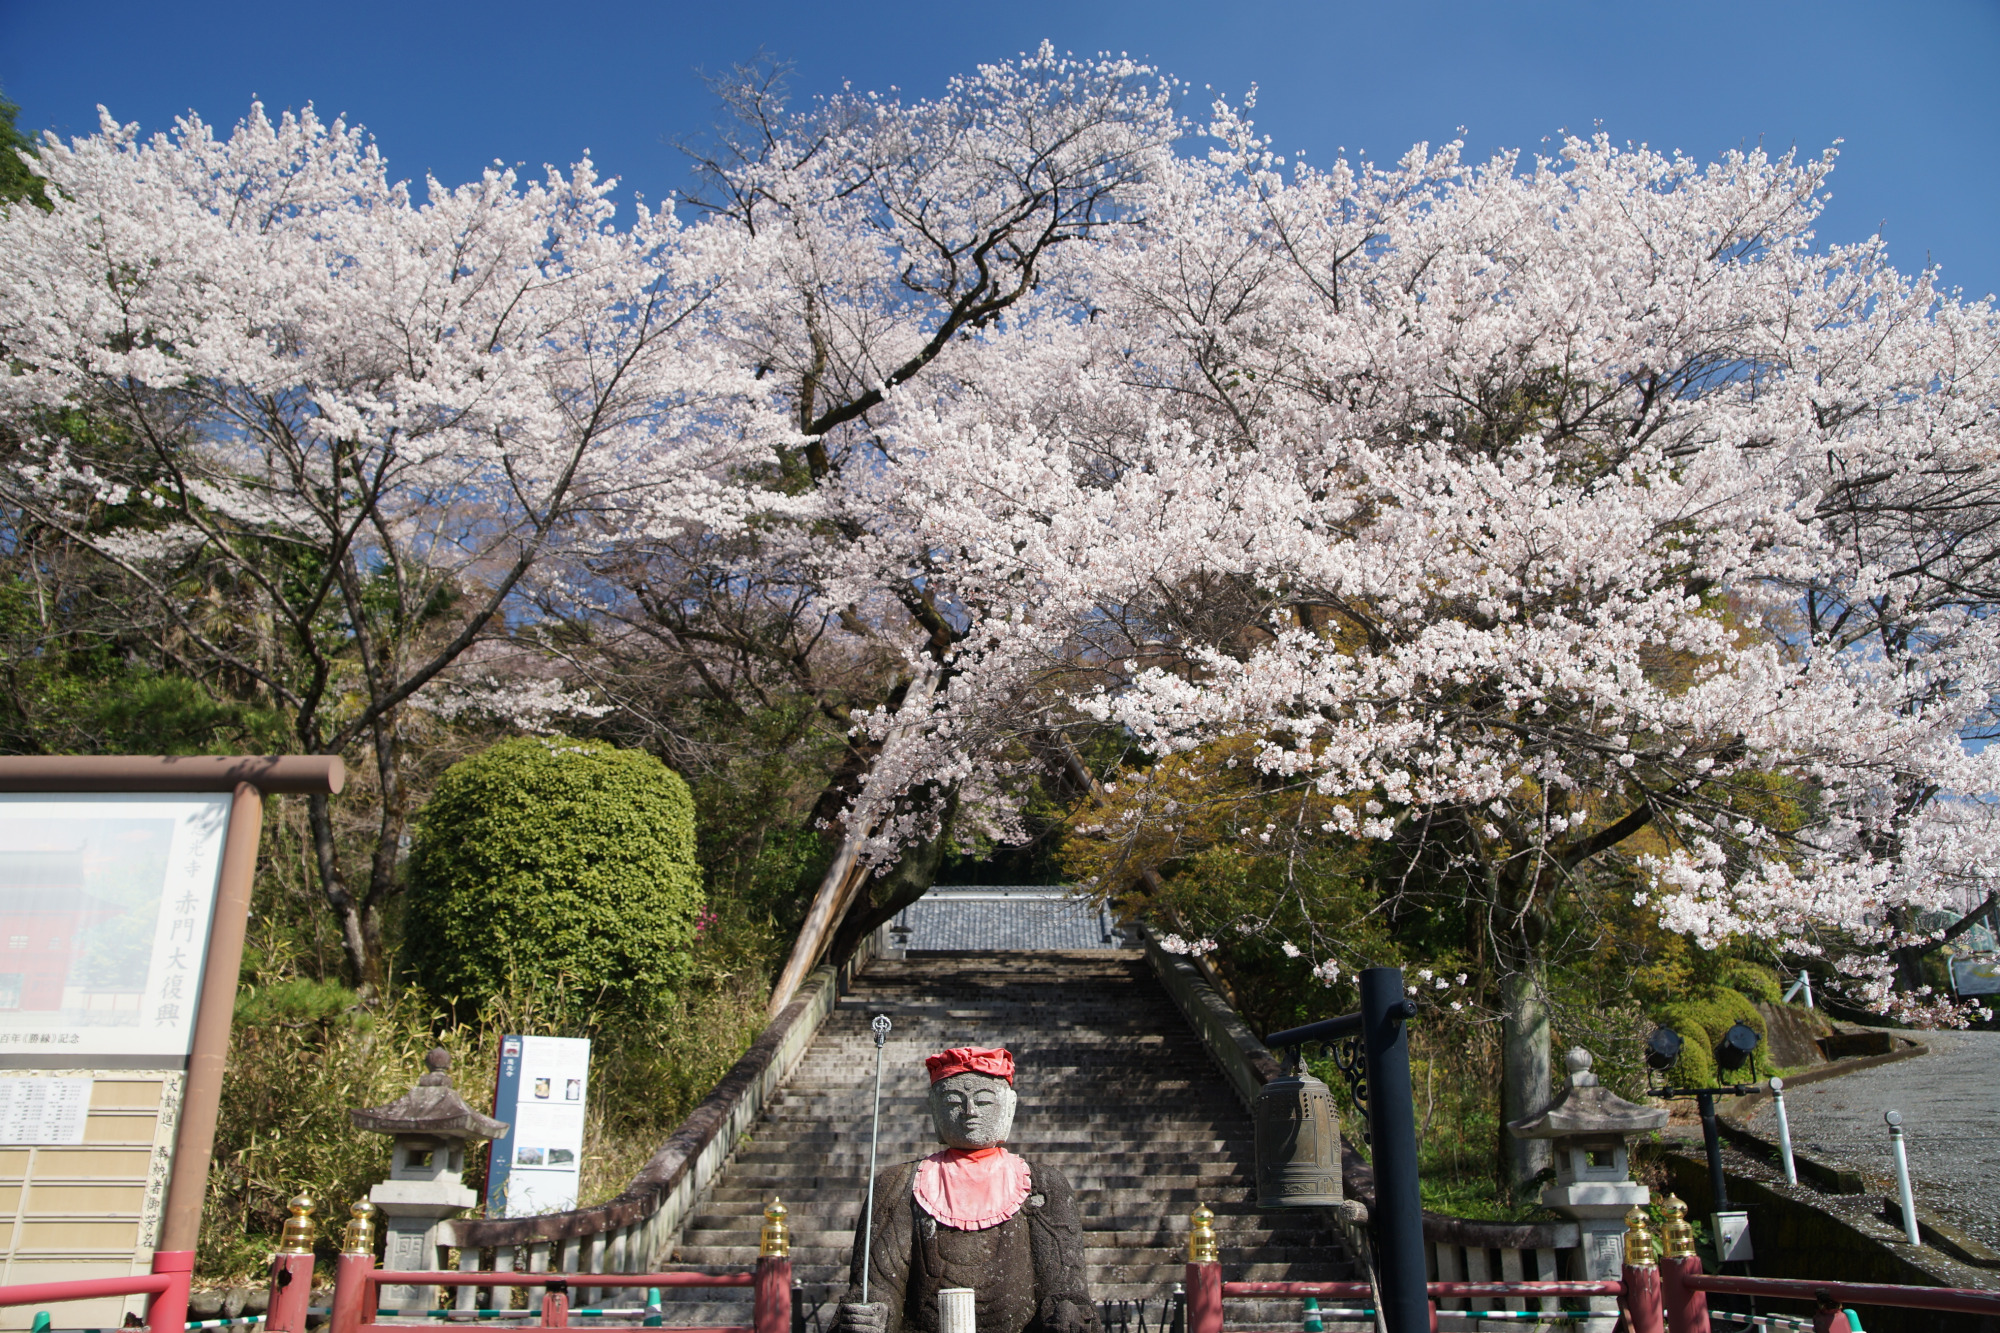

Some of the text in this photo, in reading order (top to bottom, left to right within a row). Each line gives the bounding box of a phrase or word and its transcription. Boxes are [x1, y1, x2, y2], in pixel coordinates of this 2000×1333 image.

[155, 890, 199, 1028] 赤門大復興
